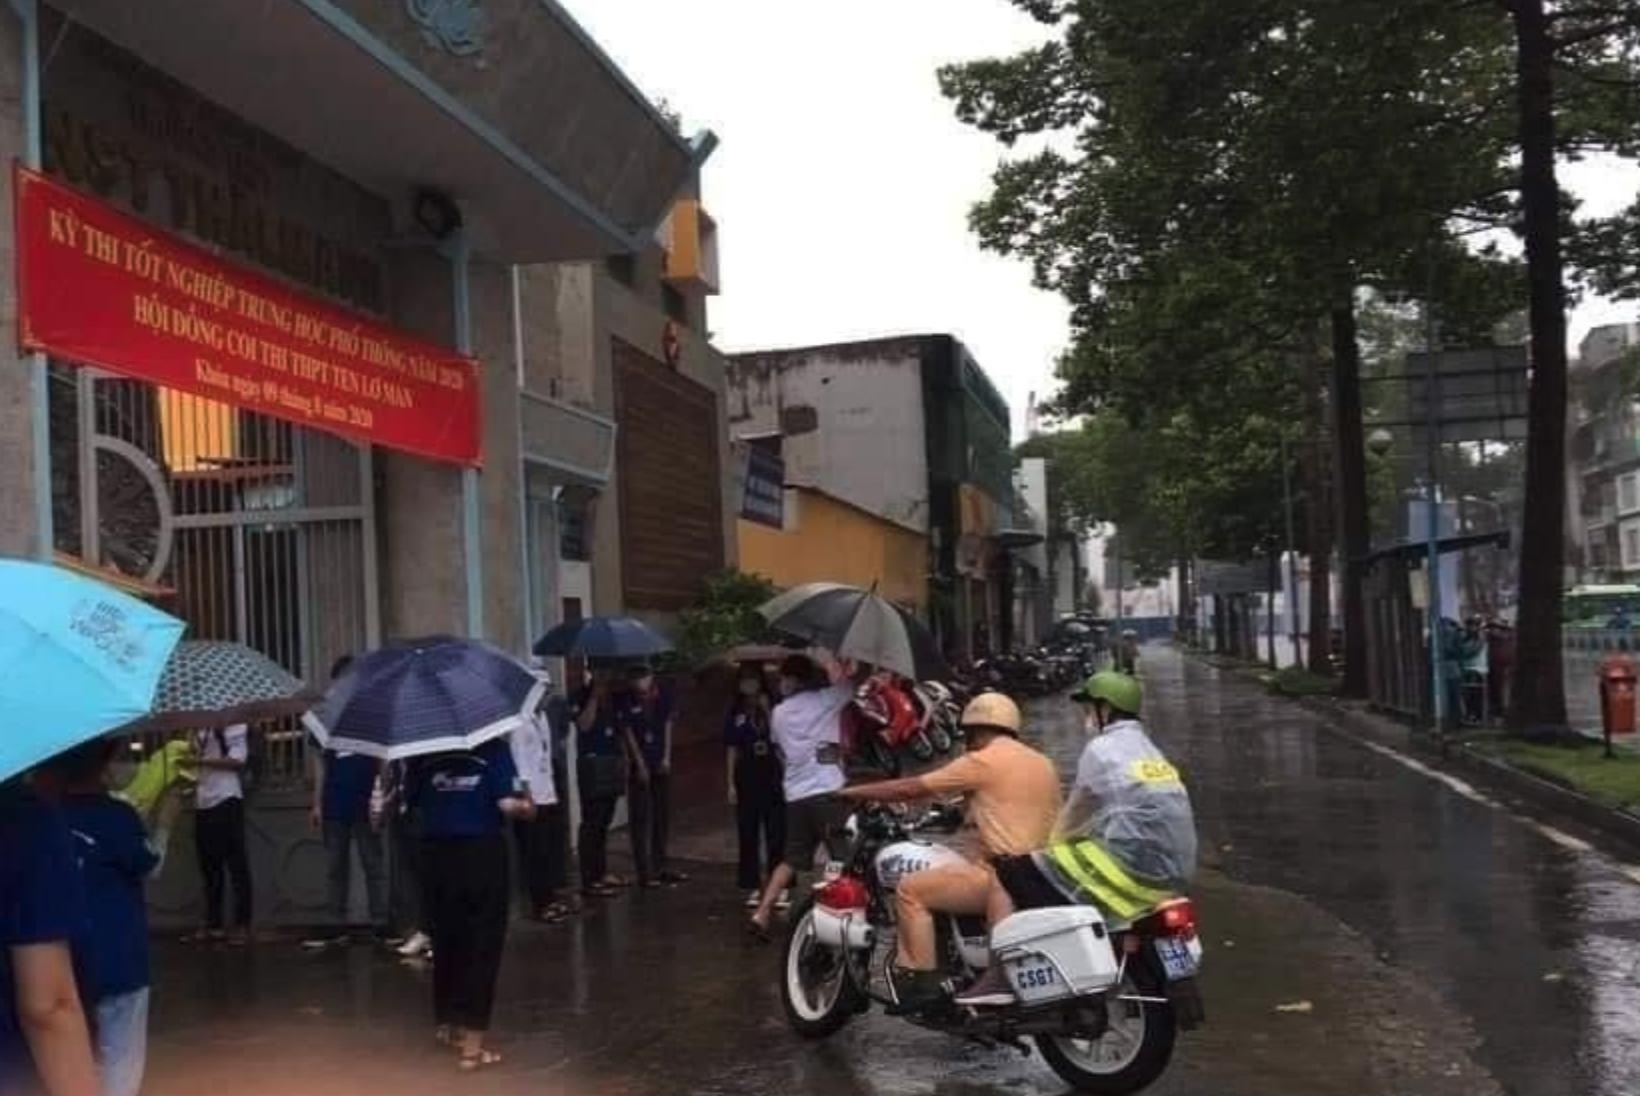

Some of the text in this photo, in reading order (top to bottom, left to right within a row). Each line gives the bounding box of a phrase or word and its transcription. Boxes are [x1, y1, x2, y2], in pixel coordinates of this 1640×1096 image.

[51, 207, 79, 248] KỲ
[83, 224, 120, 265] THI
[124, 238, 163, 283] TỐT
[168, 261, 235, 312] NGHIỆP
[238, 288, 293, 331] TRUNG
[295, 311, 327, 346] HỌC
[134, 292, 168, 336] HỘI
[227, 328, 257, 361] COI
[259, 340, 288, 372] THI
[291, 351, 329, 385] THPT
[1016, 965, 1055, 990] CSGT
